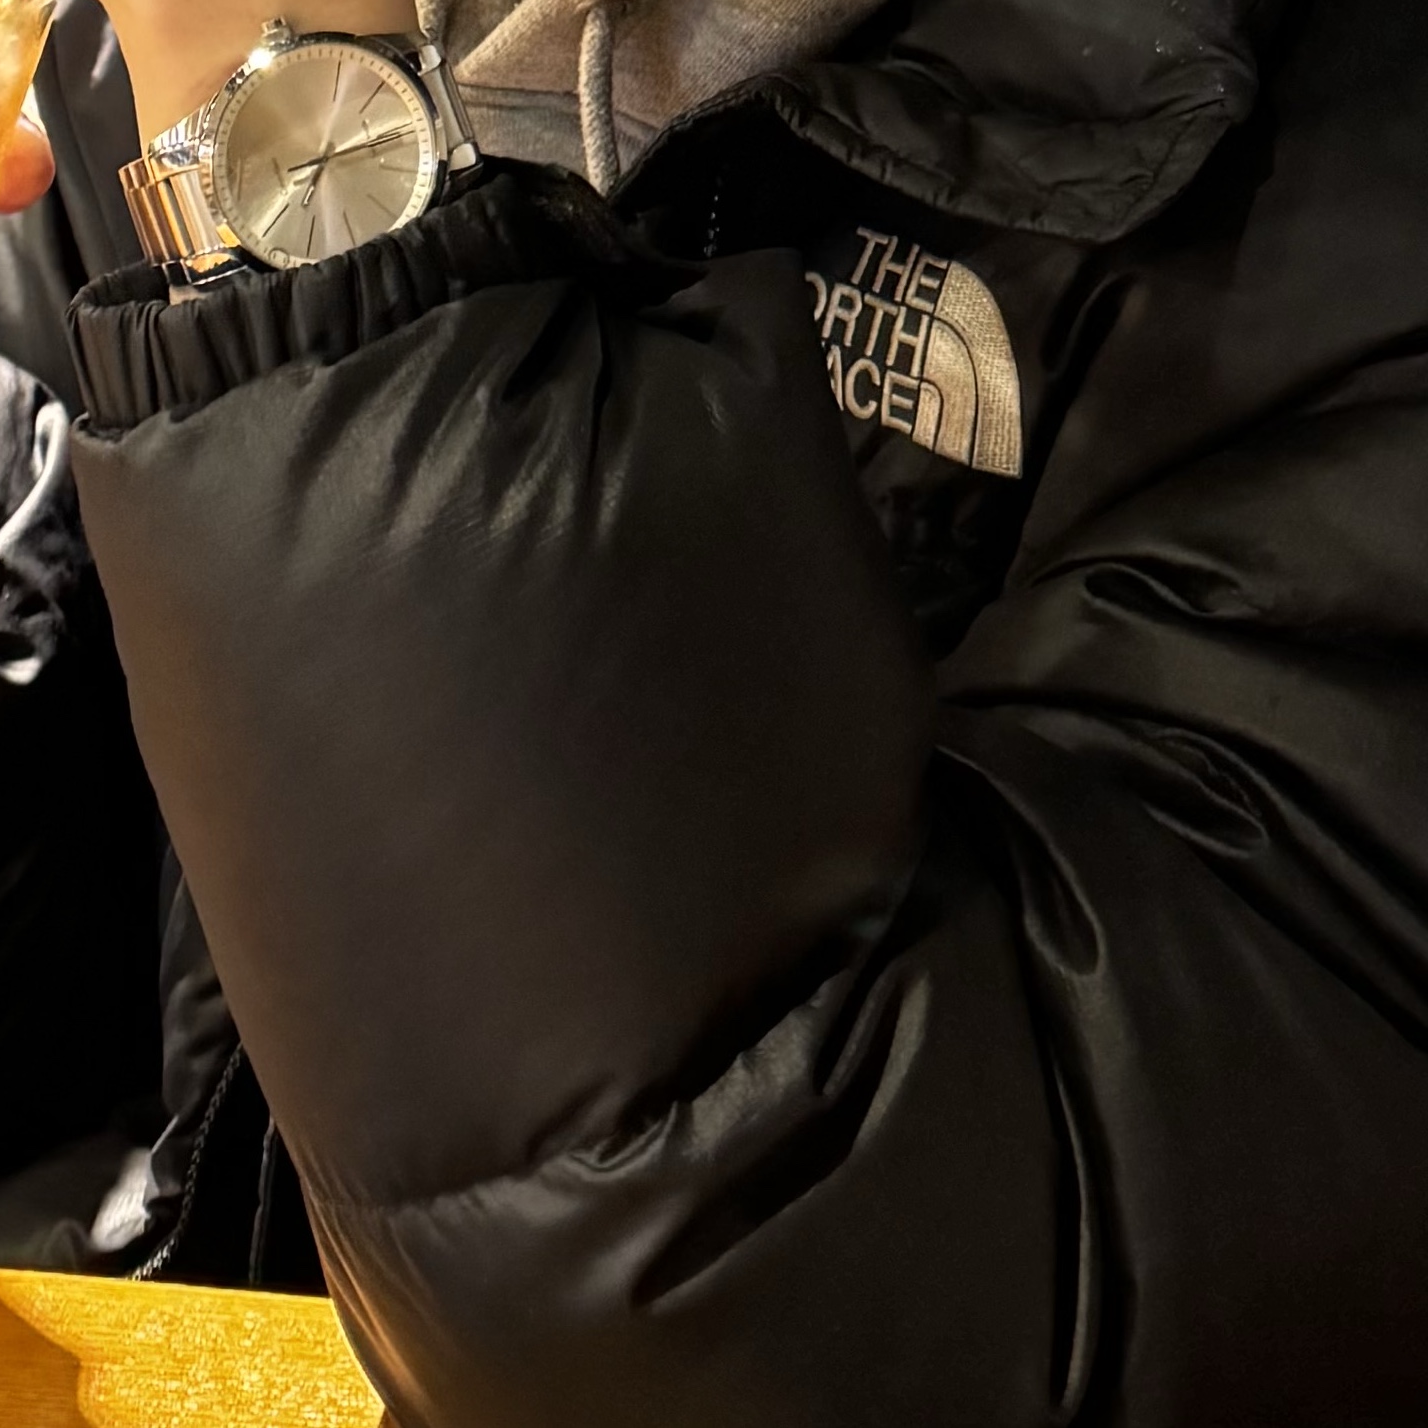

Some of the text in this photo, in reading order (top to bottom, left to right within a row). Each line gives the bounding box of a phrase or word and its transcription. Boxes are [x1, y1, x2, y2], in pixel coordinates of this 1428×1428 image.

[851, 225, 951, 313] THE
[804, 271, 930, 378] ORTH
[822, 341, 921, 436] ACE
